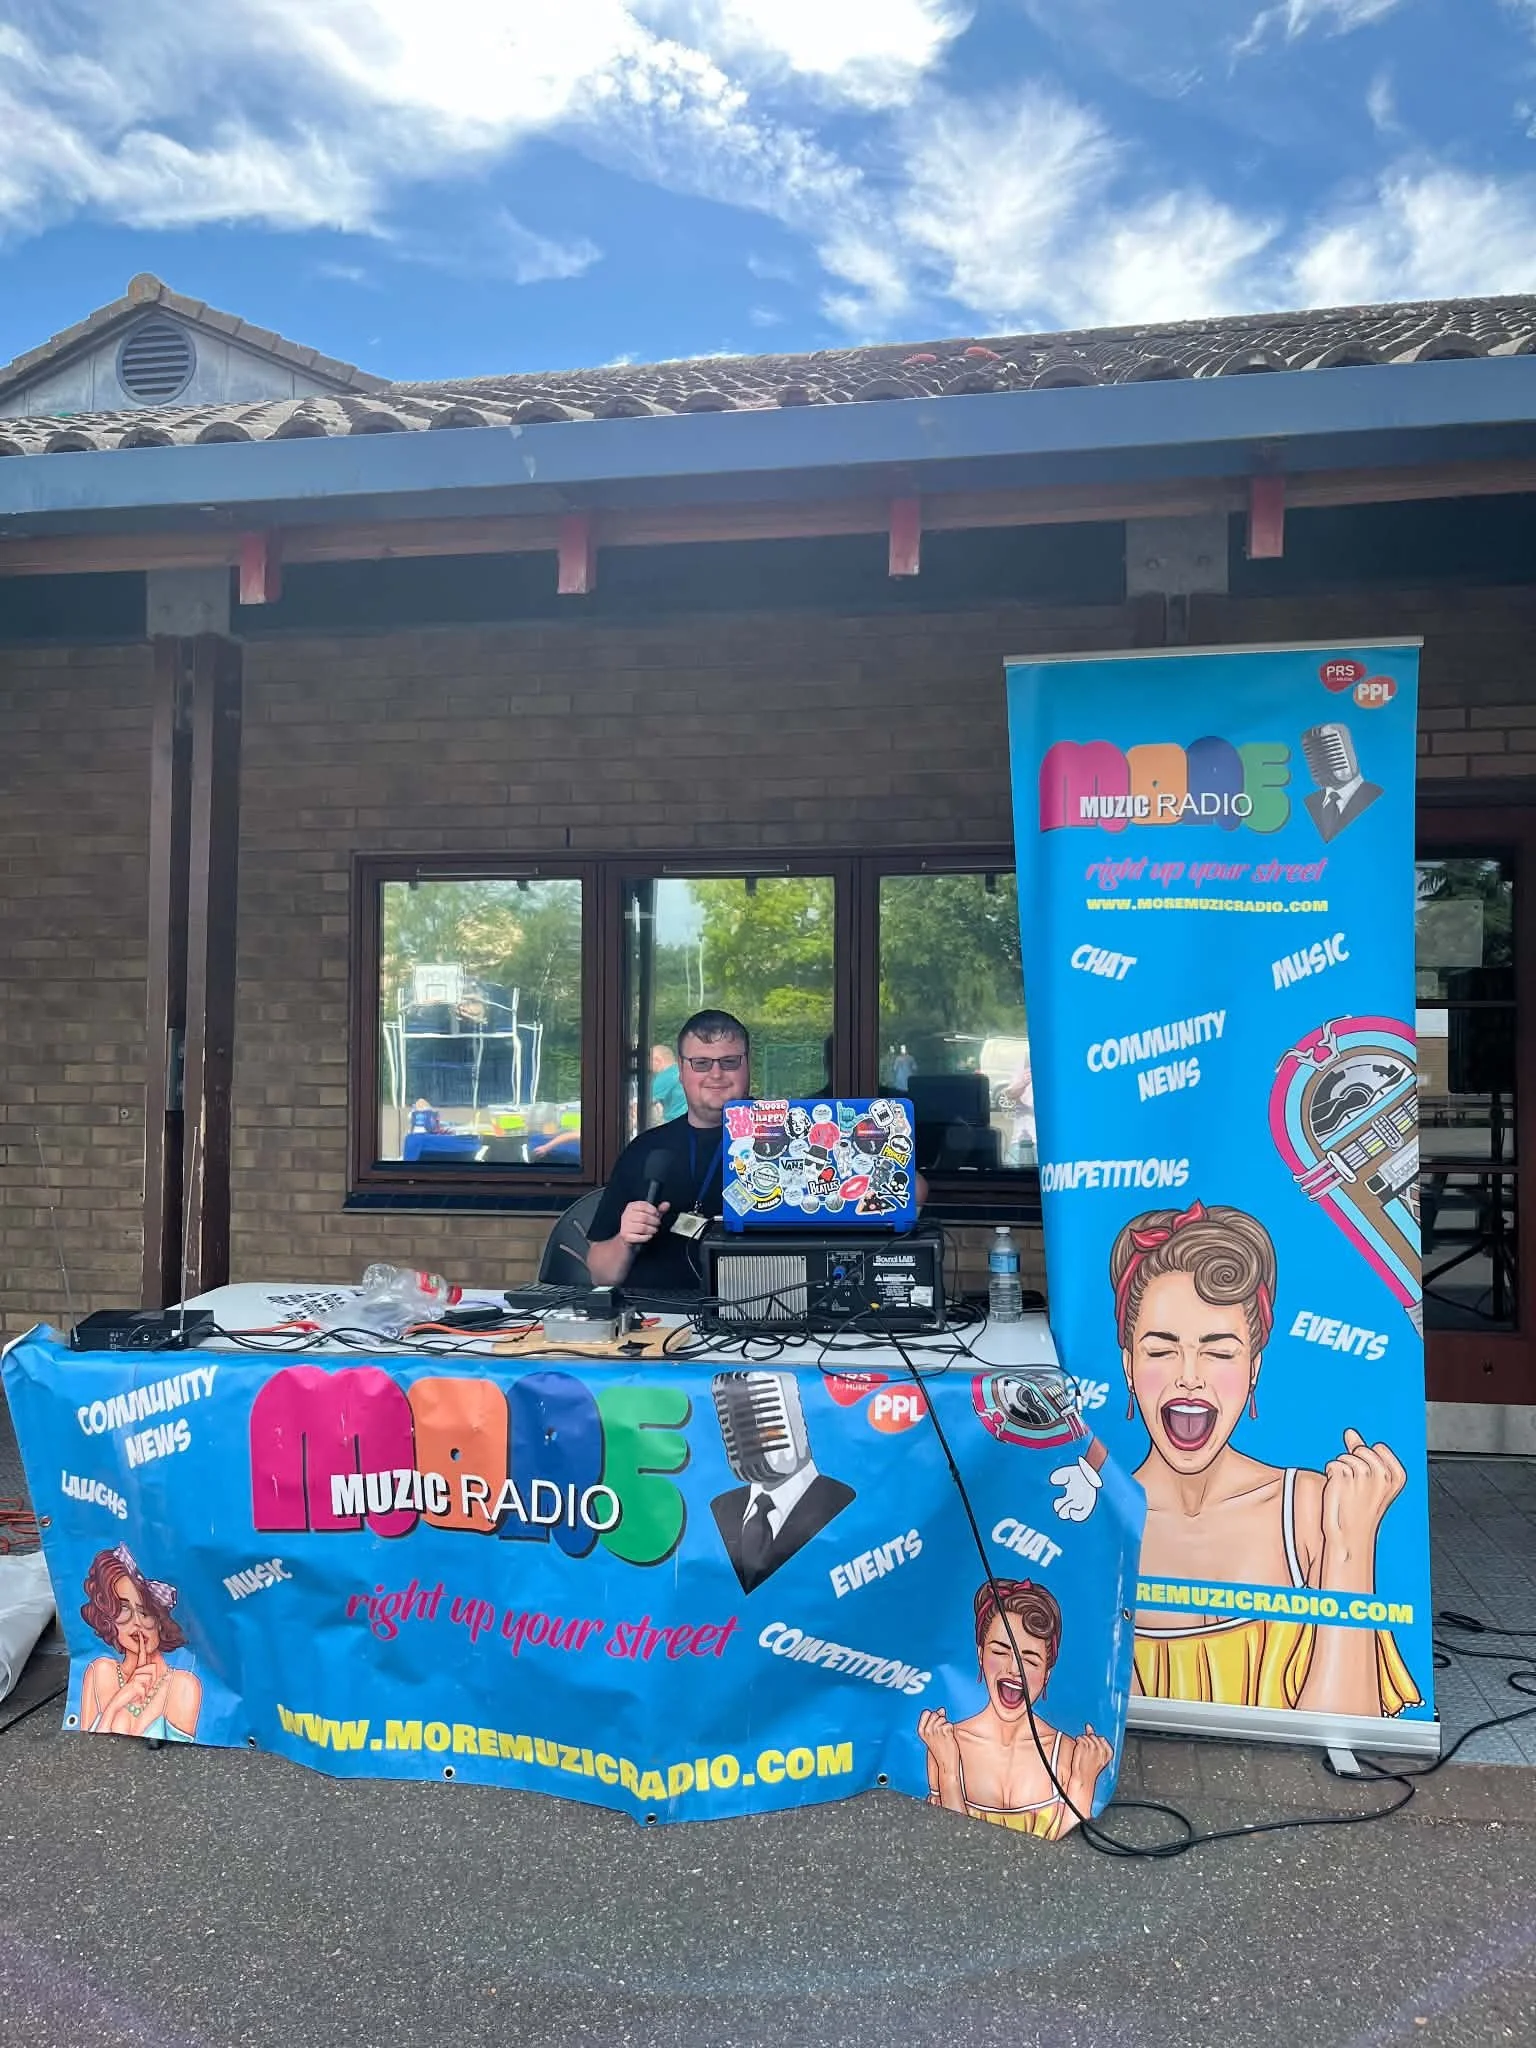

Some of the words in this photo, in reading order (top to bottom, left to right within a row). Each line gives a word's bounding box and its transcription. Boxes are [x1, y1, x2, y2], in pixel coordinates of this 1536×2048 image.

[1326, 665, 1355, 677] PRS
[1358, 683, 1393, 702] PPL
[1038, 735, 1291, 834] MORE
[1079, 795, 1150, 818] MUZIC
[1157, 792, 1253, 816] RADIO
[1086, 857, 1148, 890] right
[1150, 862, 1185, 889] up
[1188, 862, 1250, 889] your
[1252, 858, 1328, 883] street
[1086, 897, 1329, 913] WWW.MOREMUZICRADIO.COM
[1070, 943, 1137, 981] CHAT
[1272, 932, 1350, 990] MUSIC
[1086, 1009, 1227, 1073] COMMUNITY
[1137, 1057, 1202, 1102] NEWS
[755, 1113, 785, 1122] happy
[781, 1159, 804, 1171] VANS
[808, 1179, 841, 1196] BEATLES
[1041, 1158, 1190, 1193] COMPETITIONS
[1289, 1311, 1389, 1361] EVENTS
[78, 1365, 218, 1436] COMMUNITY
[874, 1394, 925, 1422] PPL
[125, 1419, 191, 1469] NEWS
[249, 1364, 692, 1566] MORE
[61, 1469, 128, 1521] LAUGHS
[330, 1468, 448, 1517] MUZIC
[459, 1475, 621, 1530] RADIO
[829, 1528, 923, 1599] EVENTS
[991, 1518, 1062, 1567] CHAT
[222, 1558, 293, 1600] MUSIC
[346, 1578, 448, 1641] right
[449, 1598, 496, 1644] up
[501, 1612, 605, 1658] your
[605, 1616, 742, 1662] street
[758, 1622, 932, 1696] COMPETITIONS
[276, 1703, 854, 1801] WWW.MOREMUZICRADIO.COM
